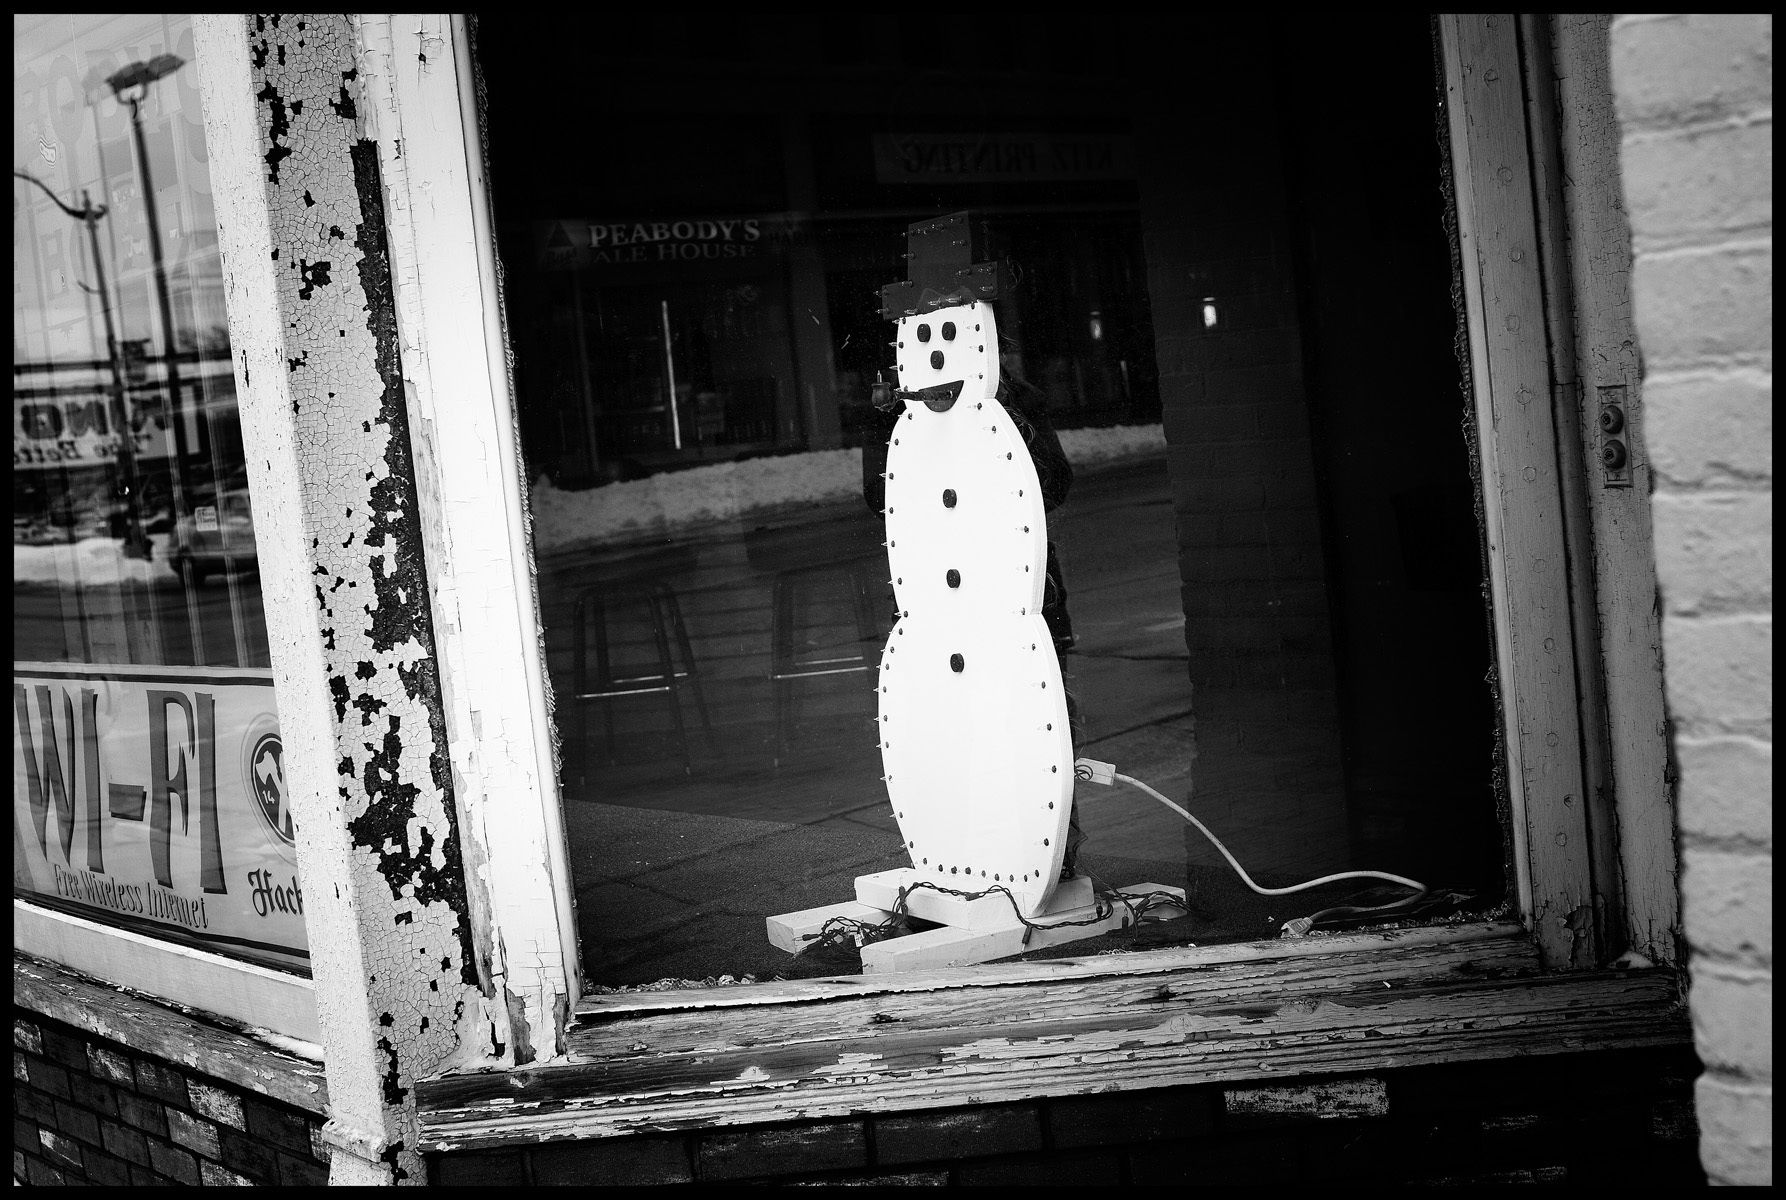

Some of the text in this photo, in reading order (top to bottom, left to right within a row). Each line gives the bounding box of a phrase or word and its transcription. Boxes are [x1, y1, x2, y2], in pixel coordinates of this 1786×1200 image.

[588, 219, 761, 248] PEABODY'S
[593, 243, 648, 264] ALE
[657, 241, 757, 261] HOUSE
[14, 683, 228, 894] WI-FI
[261, 789, 276, 805] 14
[54, 863, 209, 930] Free Wireless Internet
